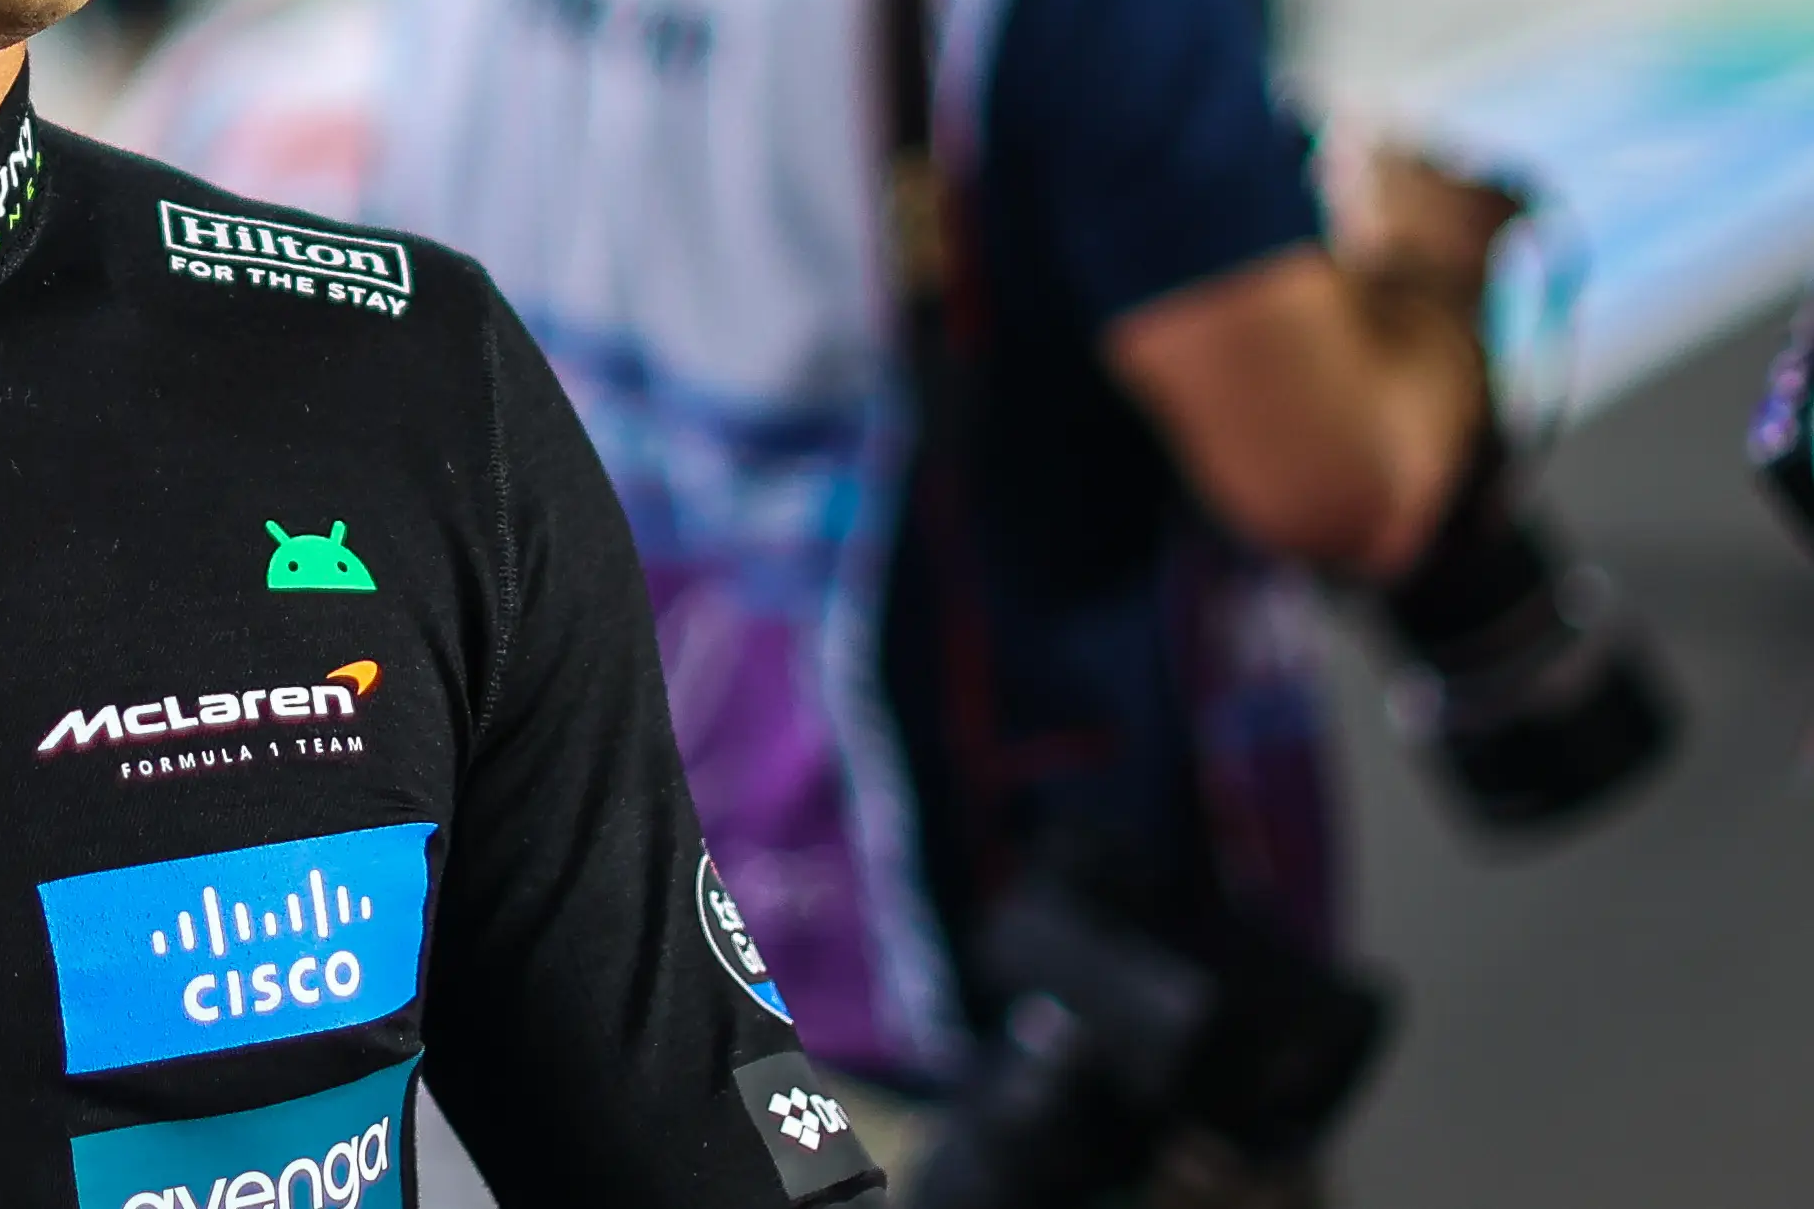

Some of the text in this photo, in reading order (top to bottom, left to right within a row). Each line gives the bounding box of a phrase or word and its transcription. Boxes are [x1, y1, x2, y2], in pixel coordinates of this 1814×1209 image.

[180, 216, 389, 276] Hilton
[171, 255, 407, 317] FOR THE STAY
[120, 735, 364, 779] FORMULA 1 TEAM
[183, 950, 361, 1023] CISCO
